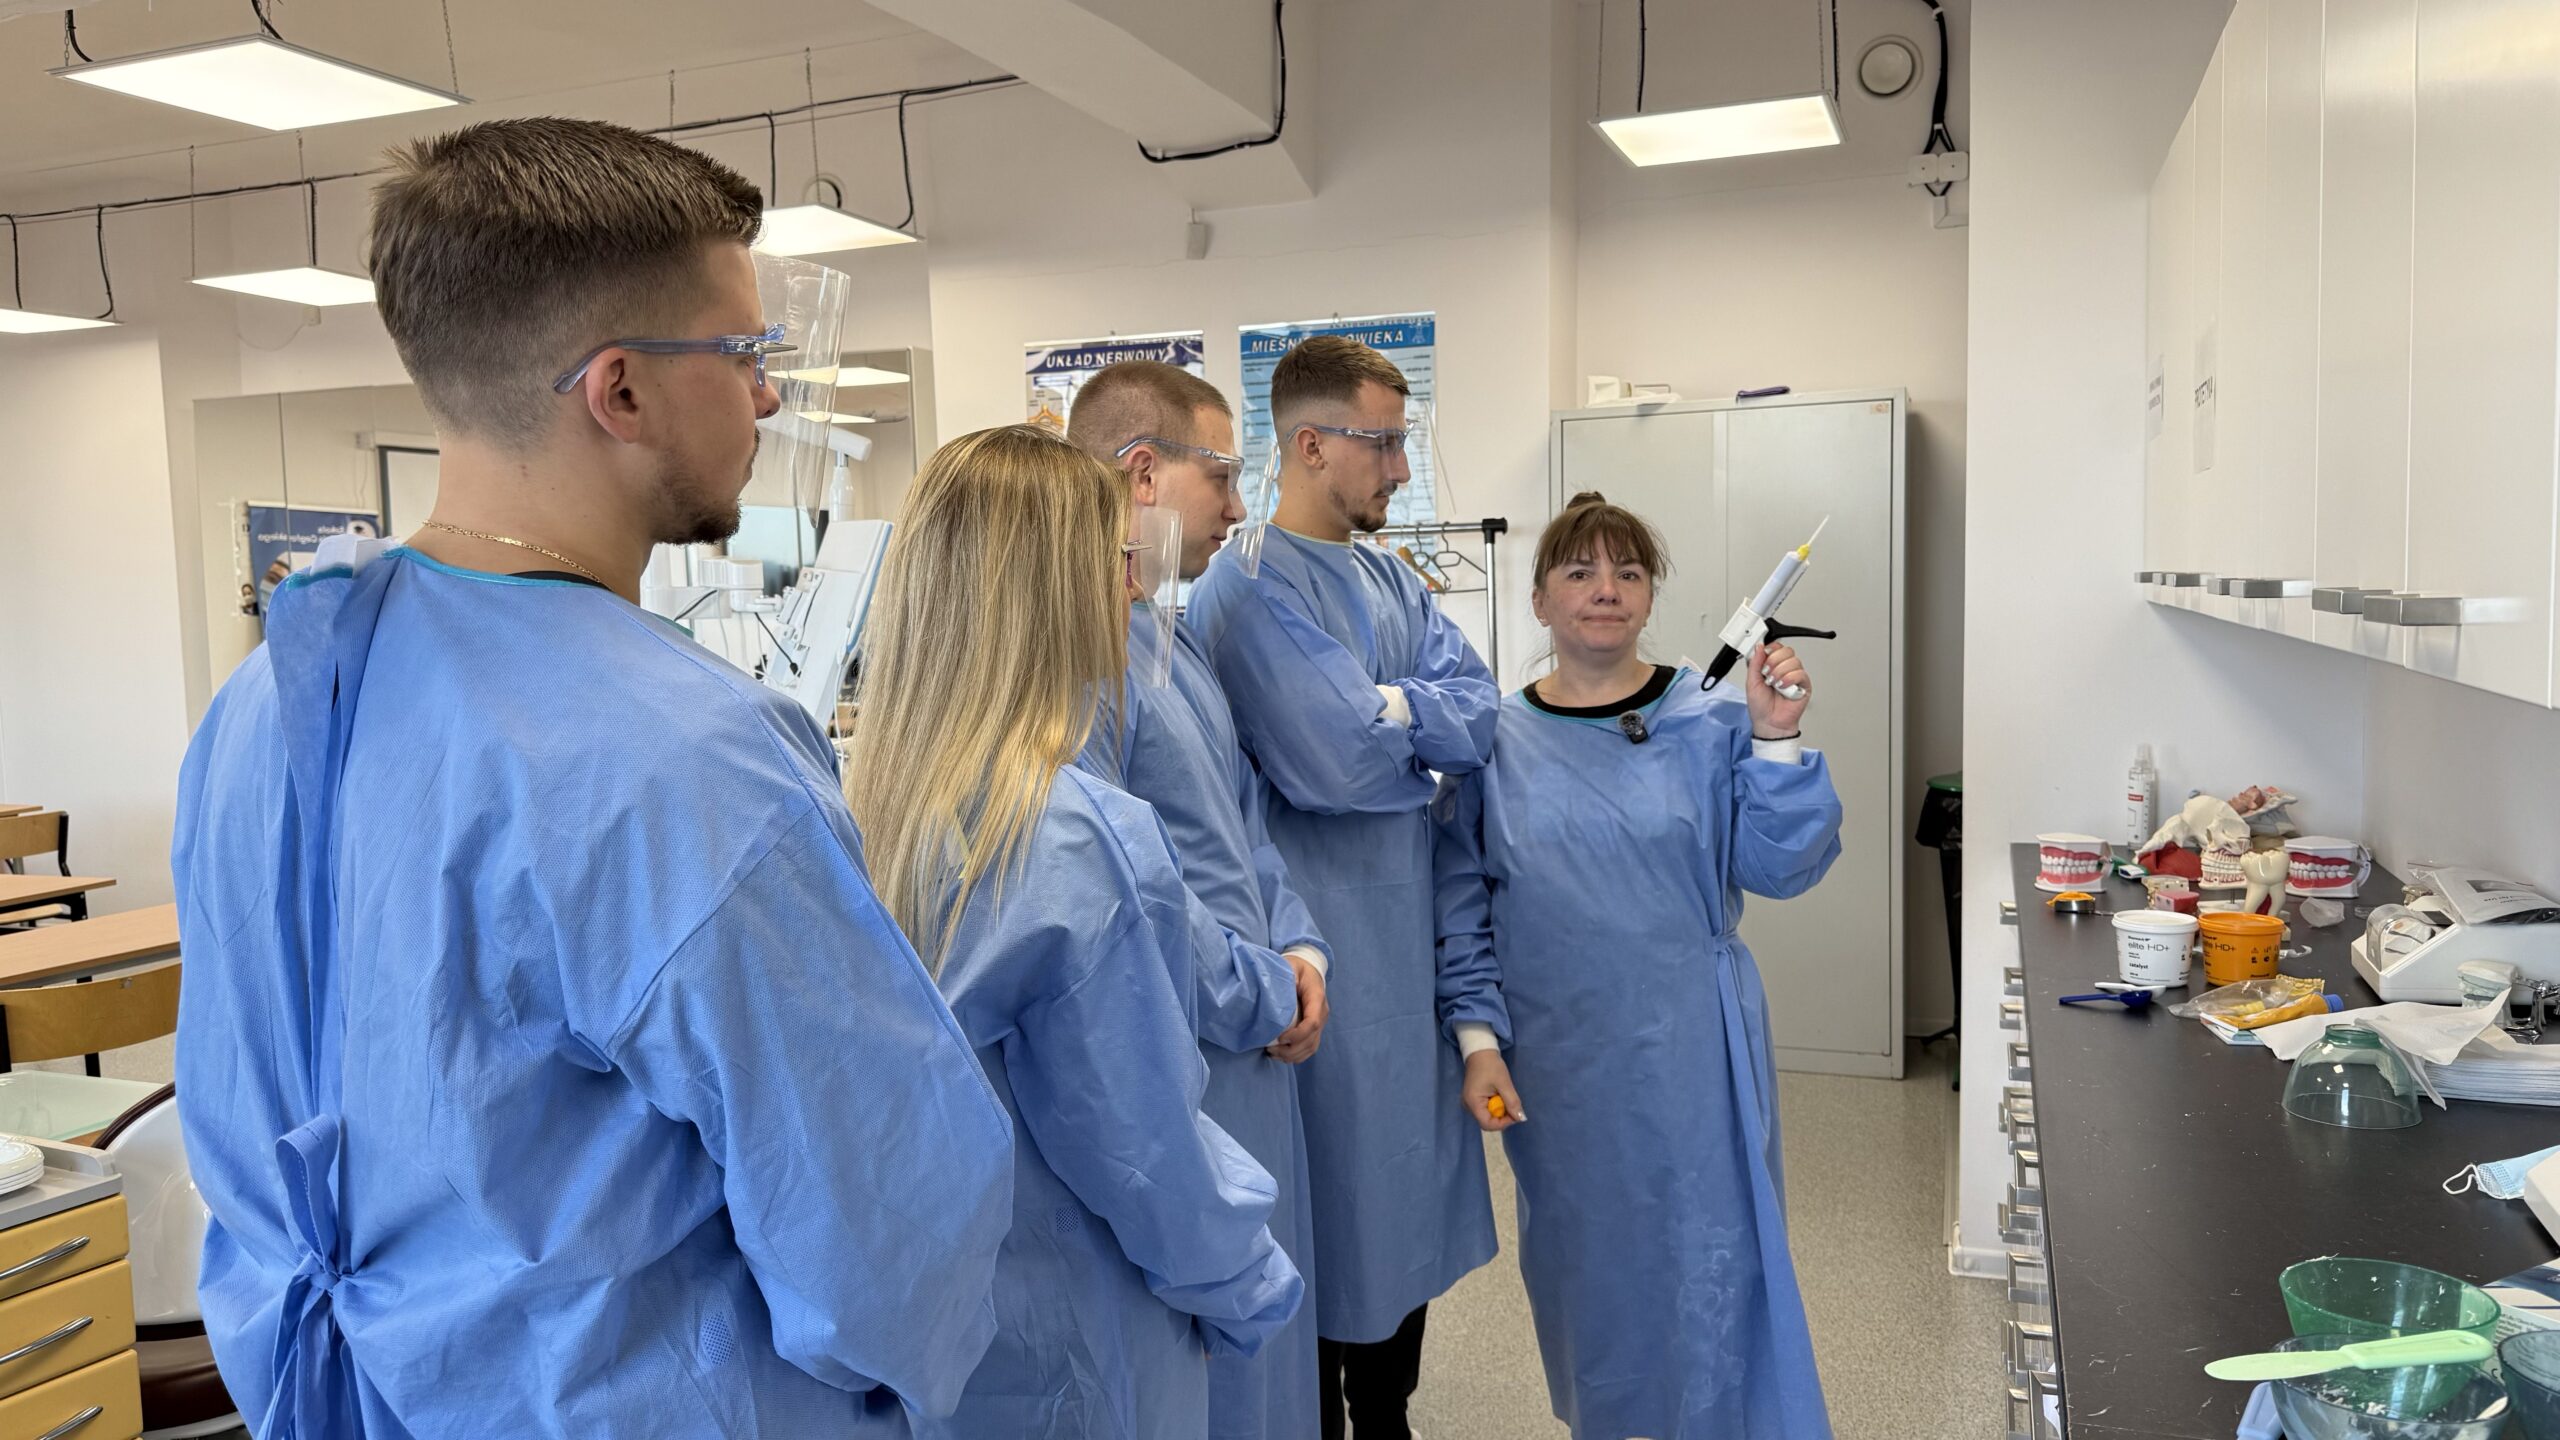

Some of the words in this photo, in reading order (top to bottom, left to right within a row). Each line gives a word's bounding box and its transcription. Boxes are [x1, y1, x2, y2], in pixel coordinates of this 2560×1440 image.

[1336, 330, 1404, 346] OWIEKA
[1046, 353, 1093, 369] UKŁAD
[1095, 349, 1167, 366] NERWOWY
[2147, 944, 2170, 952] HD+
[2215, 943, 2236, 952] HD+
